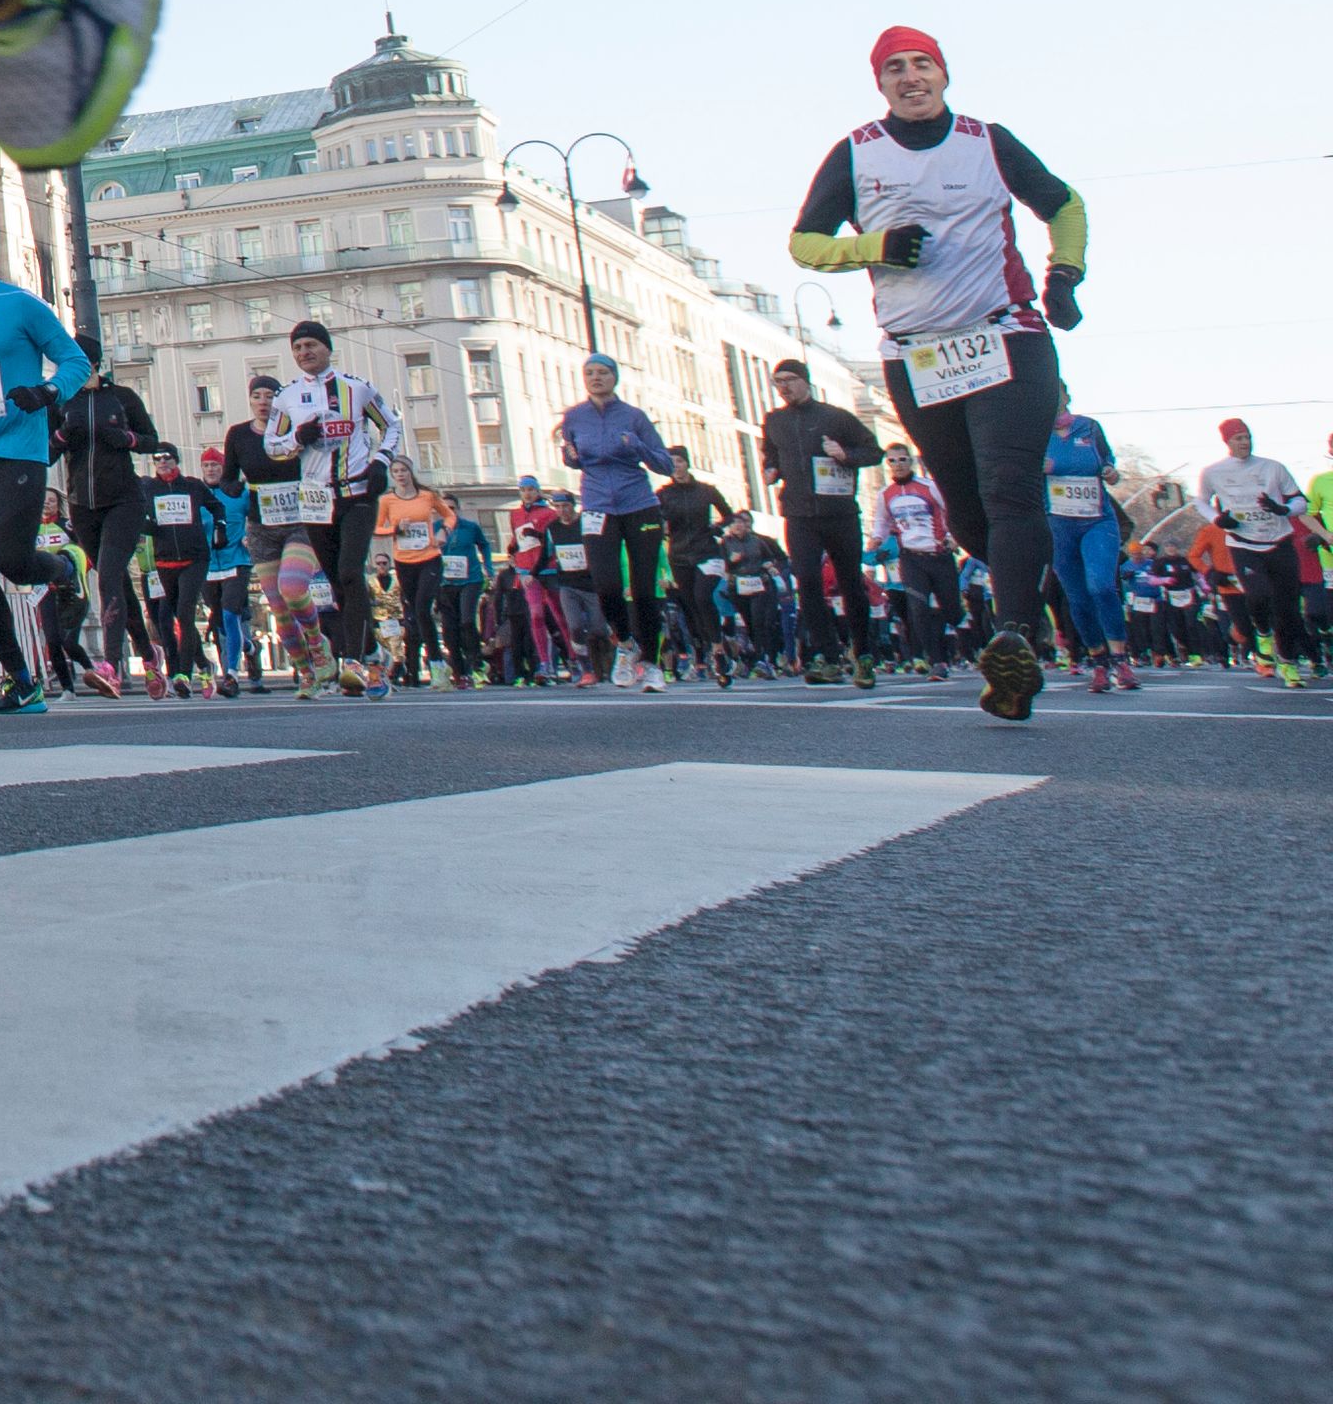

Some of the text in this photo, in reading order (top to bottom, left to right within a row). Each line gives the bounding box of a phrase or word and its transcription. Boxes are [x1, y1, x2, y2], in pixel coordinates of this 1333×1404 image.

[937, 334, 991, 364] 1132
[935, 361, 982, 380] Viktor
[938, 376, 992, 398] LCC-Wien
[324, 422, 352, 435] GER
[1066, 486, 1097, 500] 3906
[166, 501, 186, 511] 2314
